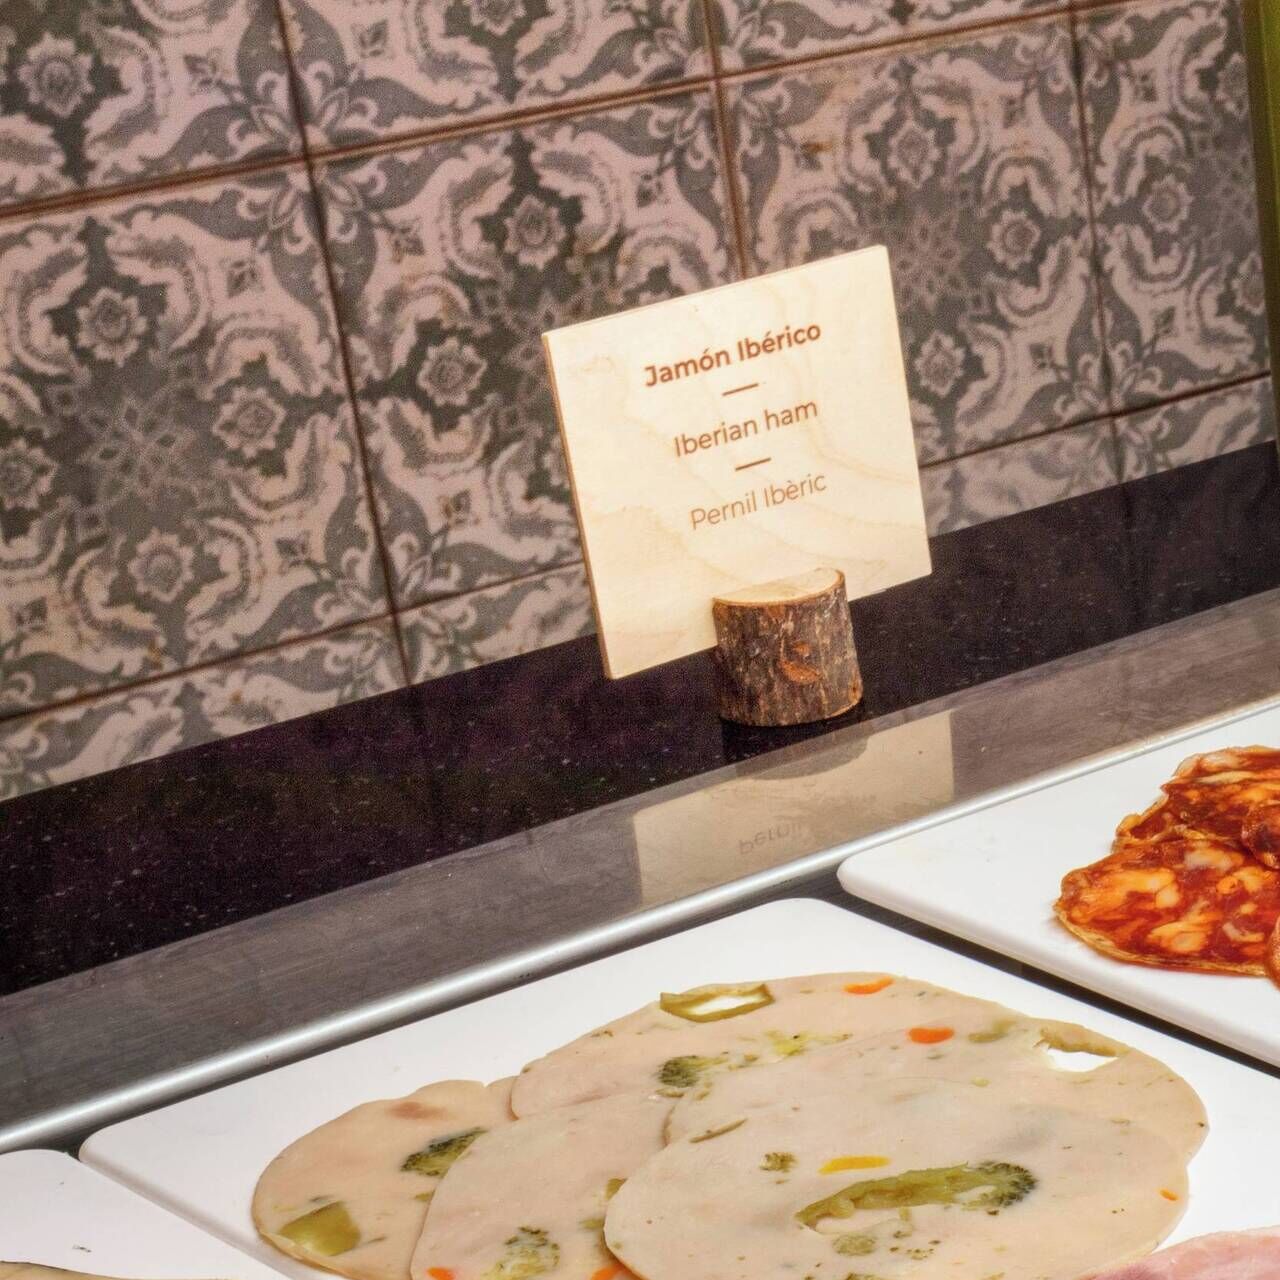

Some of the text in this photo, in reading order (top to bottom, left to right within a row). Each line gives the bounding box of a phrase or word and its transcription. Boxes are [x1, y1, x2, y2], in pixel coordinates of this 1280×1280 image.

[644, 324, 821, 387] Jamón Ibérico
[674, 401, 818, 457] Iberian ham
[690, 474, 827, 530] Pernil Ibèric
